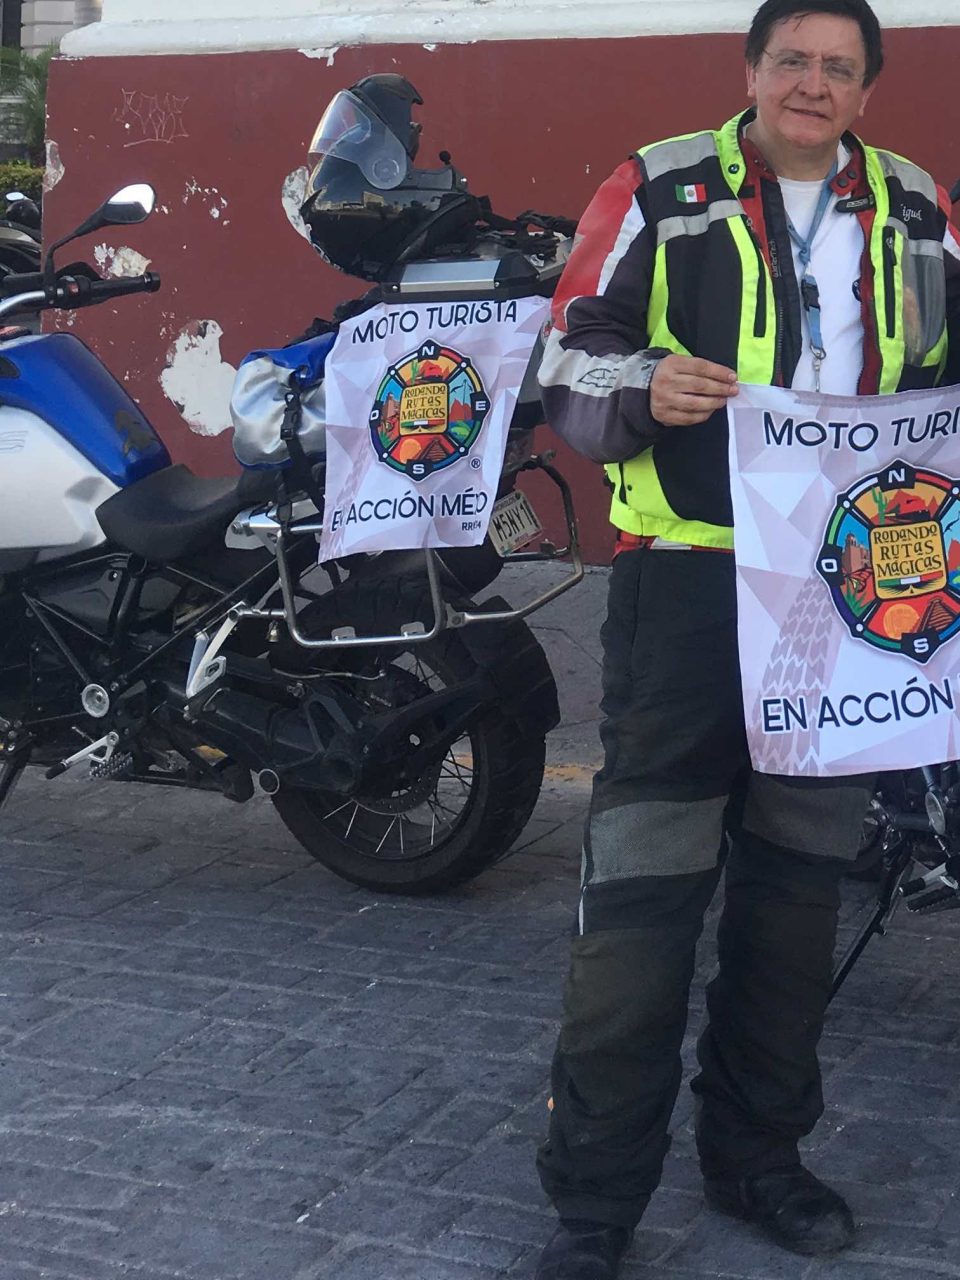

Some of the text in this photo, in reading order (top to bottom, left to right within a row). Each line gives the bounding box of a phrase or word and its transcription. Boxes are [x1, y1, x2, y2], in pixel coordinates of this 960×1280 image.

[352, 300, 518, 344] MOTO TURISTA
[422, 346, 435, 356] N
[475, 400, 487, 411] E
[763, 411, 879, 453] MOTO
[412, 464, 425, 474] S
[888, 468, 905, 483] N
[346, 490, 434, 525] ACCIÓN
[913, 638, 930, 653] S
[762, 696, 808, 733] EN
[817, 673, 954, 729] ACCIÓN
